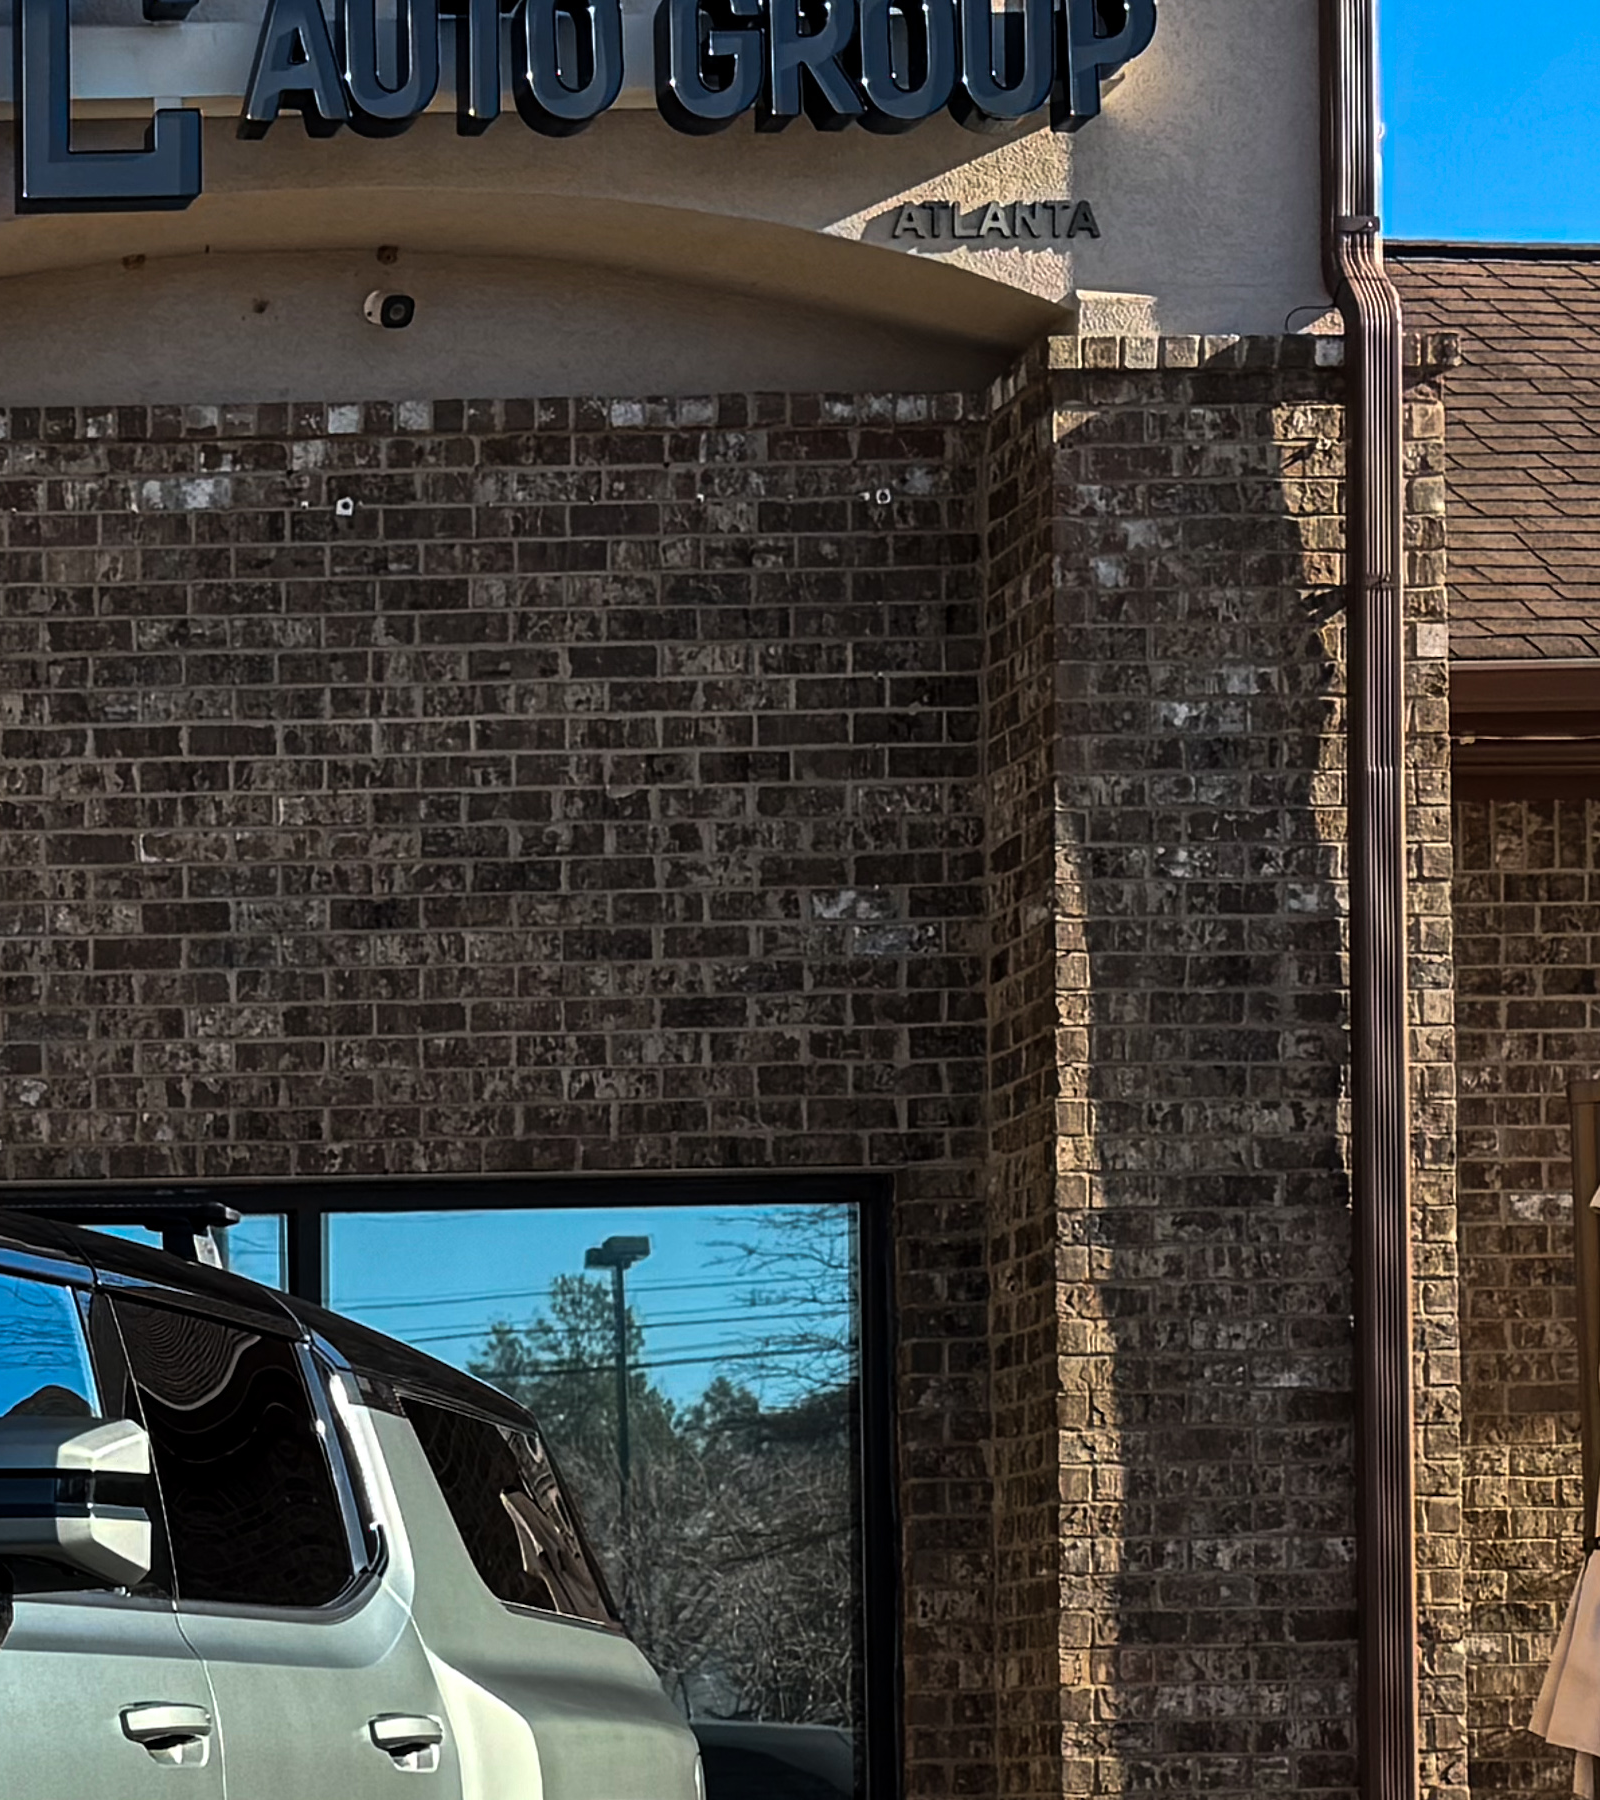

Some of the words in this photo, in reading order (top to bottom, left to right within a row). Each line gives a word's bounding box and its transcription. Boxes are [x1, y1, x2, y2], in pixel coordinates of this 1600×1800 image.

[238, 0, 624, 138] AUTO
[656, 0, 1158, 133] GROUP
[892, 200, 1101, 239] ATLANTA
